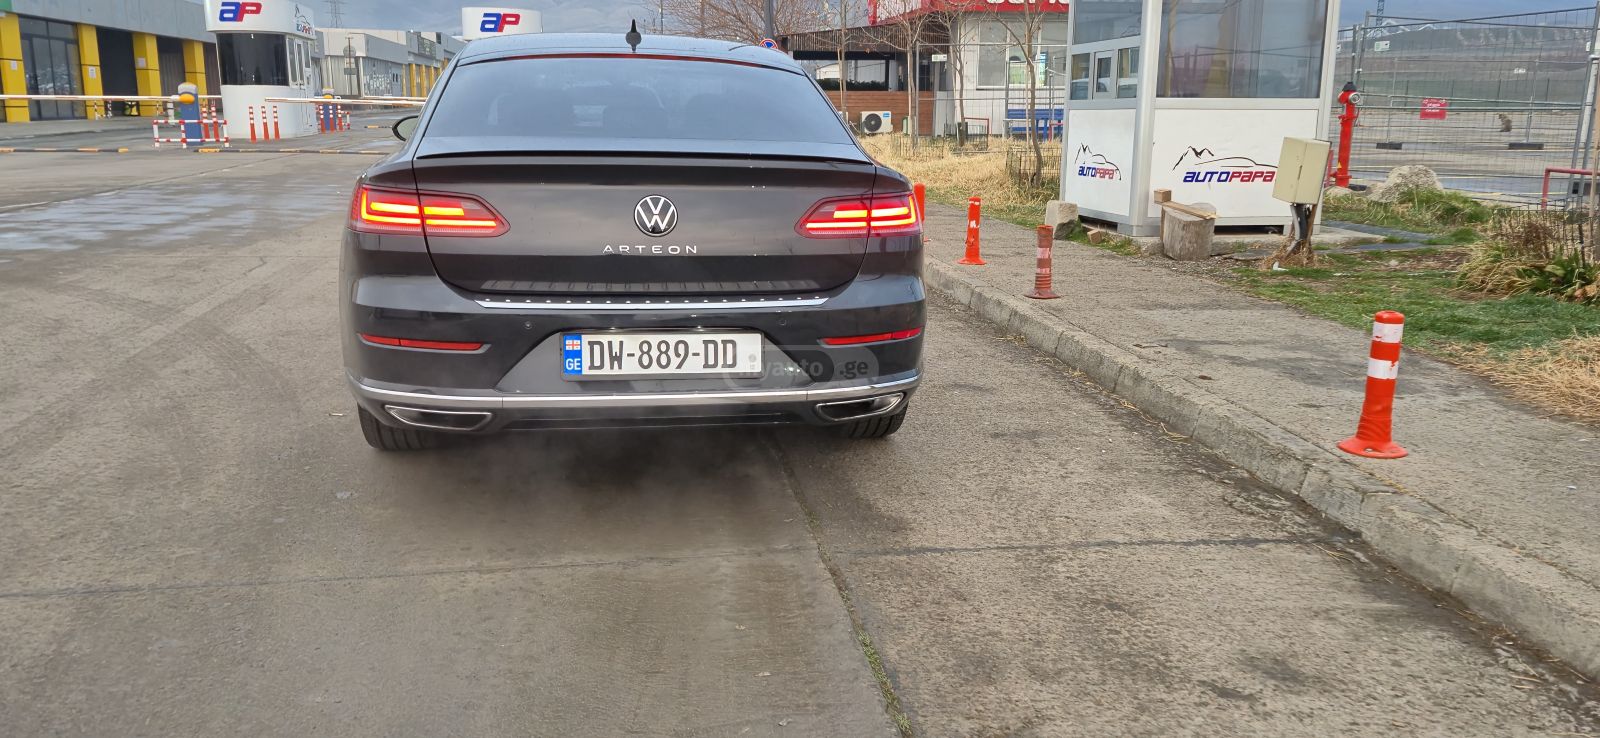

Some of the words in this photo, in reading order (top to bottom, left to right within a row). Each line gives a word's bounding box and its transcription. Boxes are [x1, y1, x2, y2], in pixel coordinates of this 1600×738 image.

[602, 245, 697, 254] ARTEON
[588, 339, 737, 371] DW-889-DD
[565, 358, 581, 371] GE
